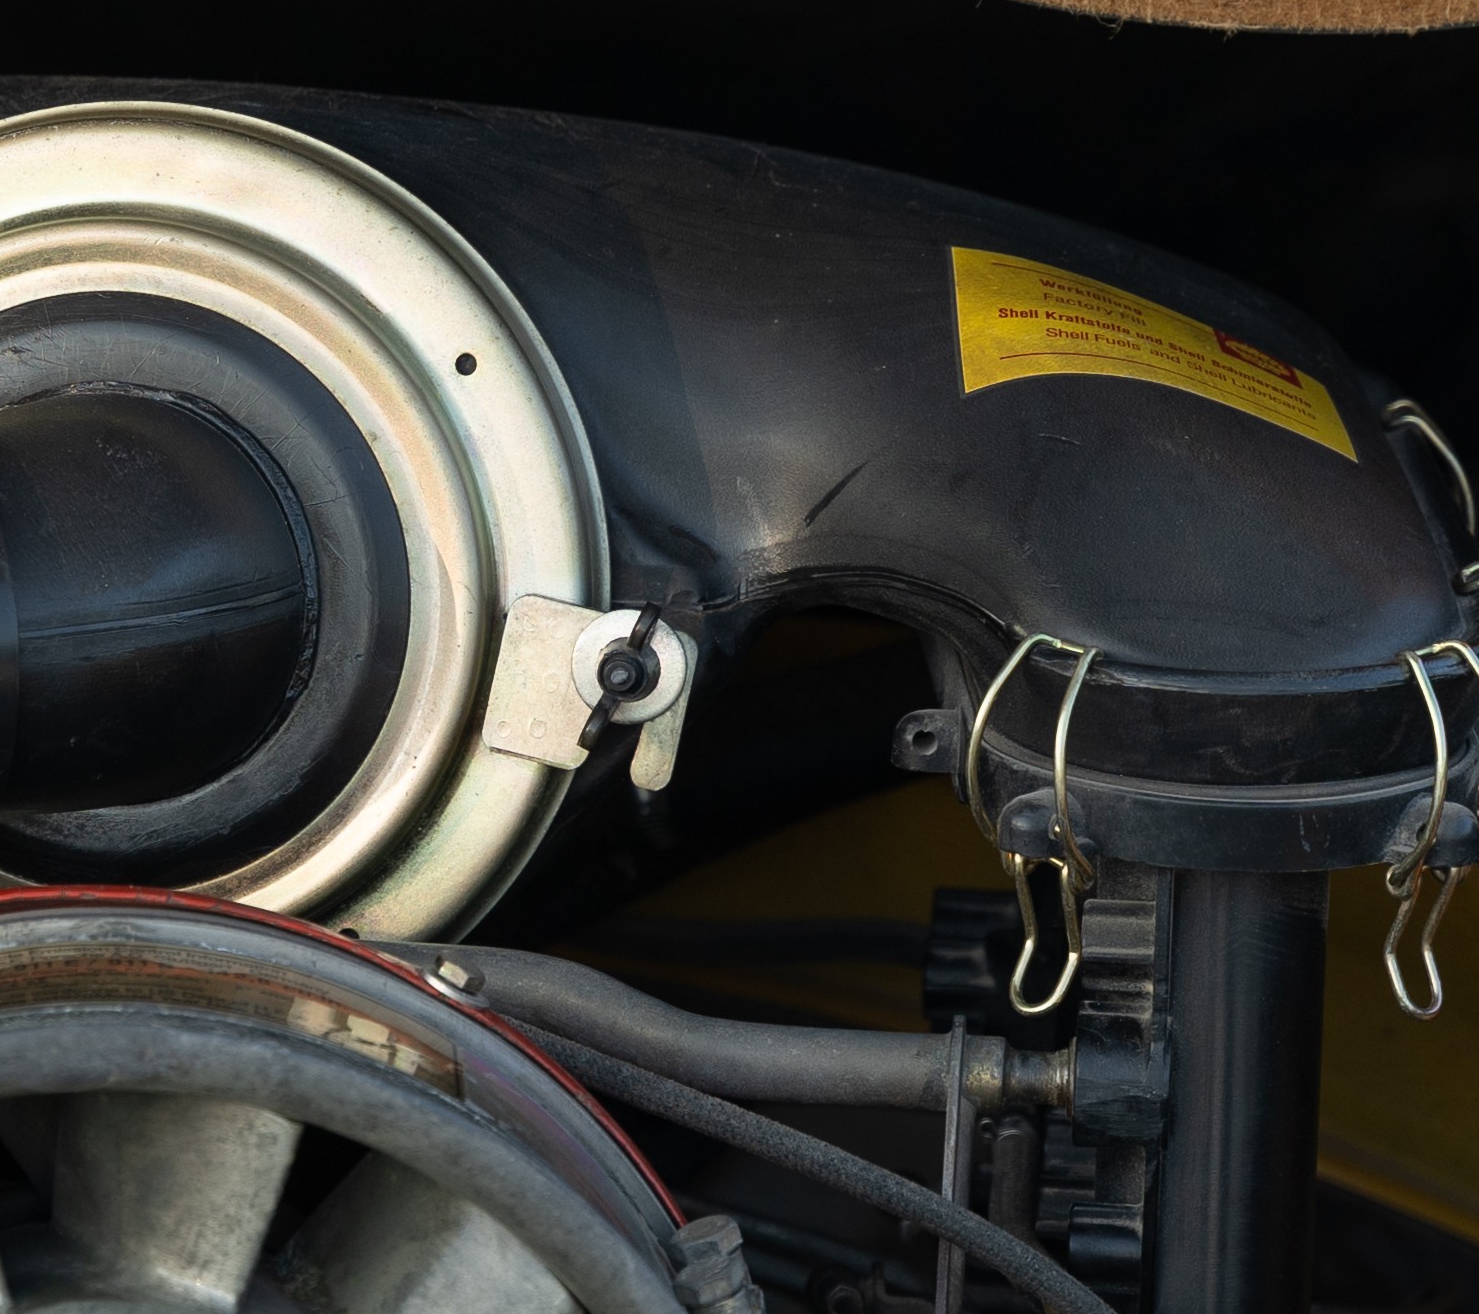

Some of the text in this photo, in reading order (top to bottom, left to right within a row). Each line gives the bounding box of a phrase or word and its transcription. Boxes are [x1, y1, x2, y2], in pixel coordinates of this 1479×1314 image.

[998, 307, 1039, 320] Shell
[1136, 331, 1163, 346] und
[1168, 338, 1206, 363] Shell
[1043, 292, 1148, 327] Factory Fill
[1045, 327, 1317, 421] Shell Fuels and Shell Lubricants
